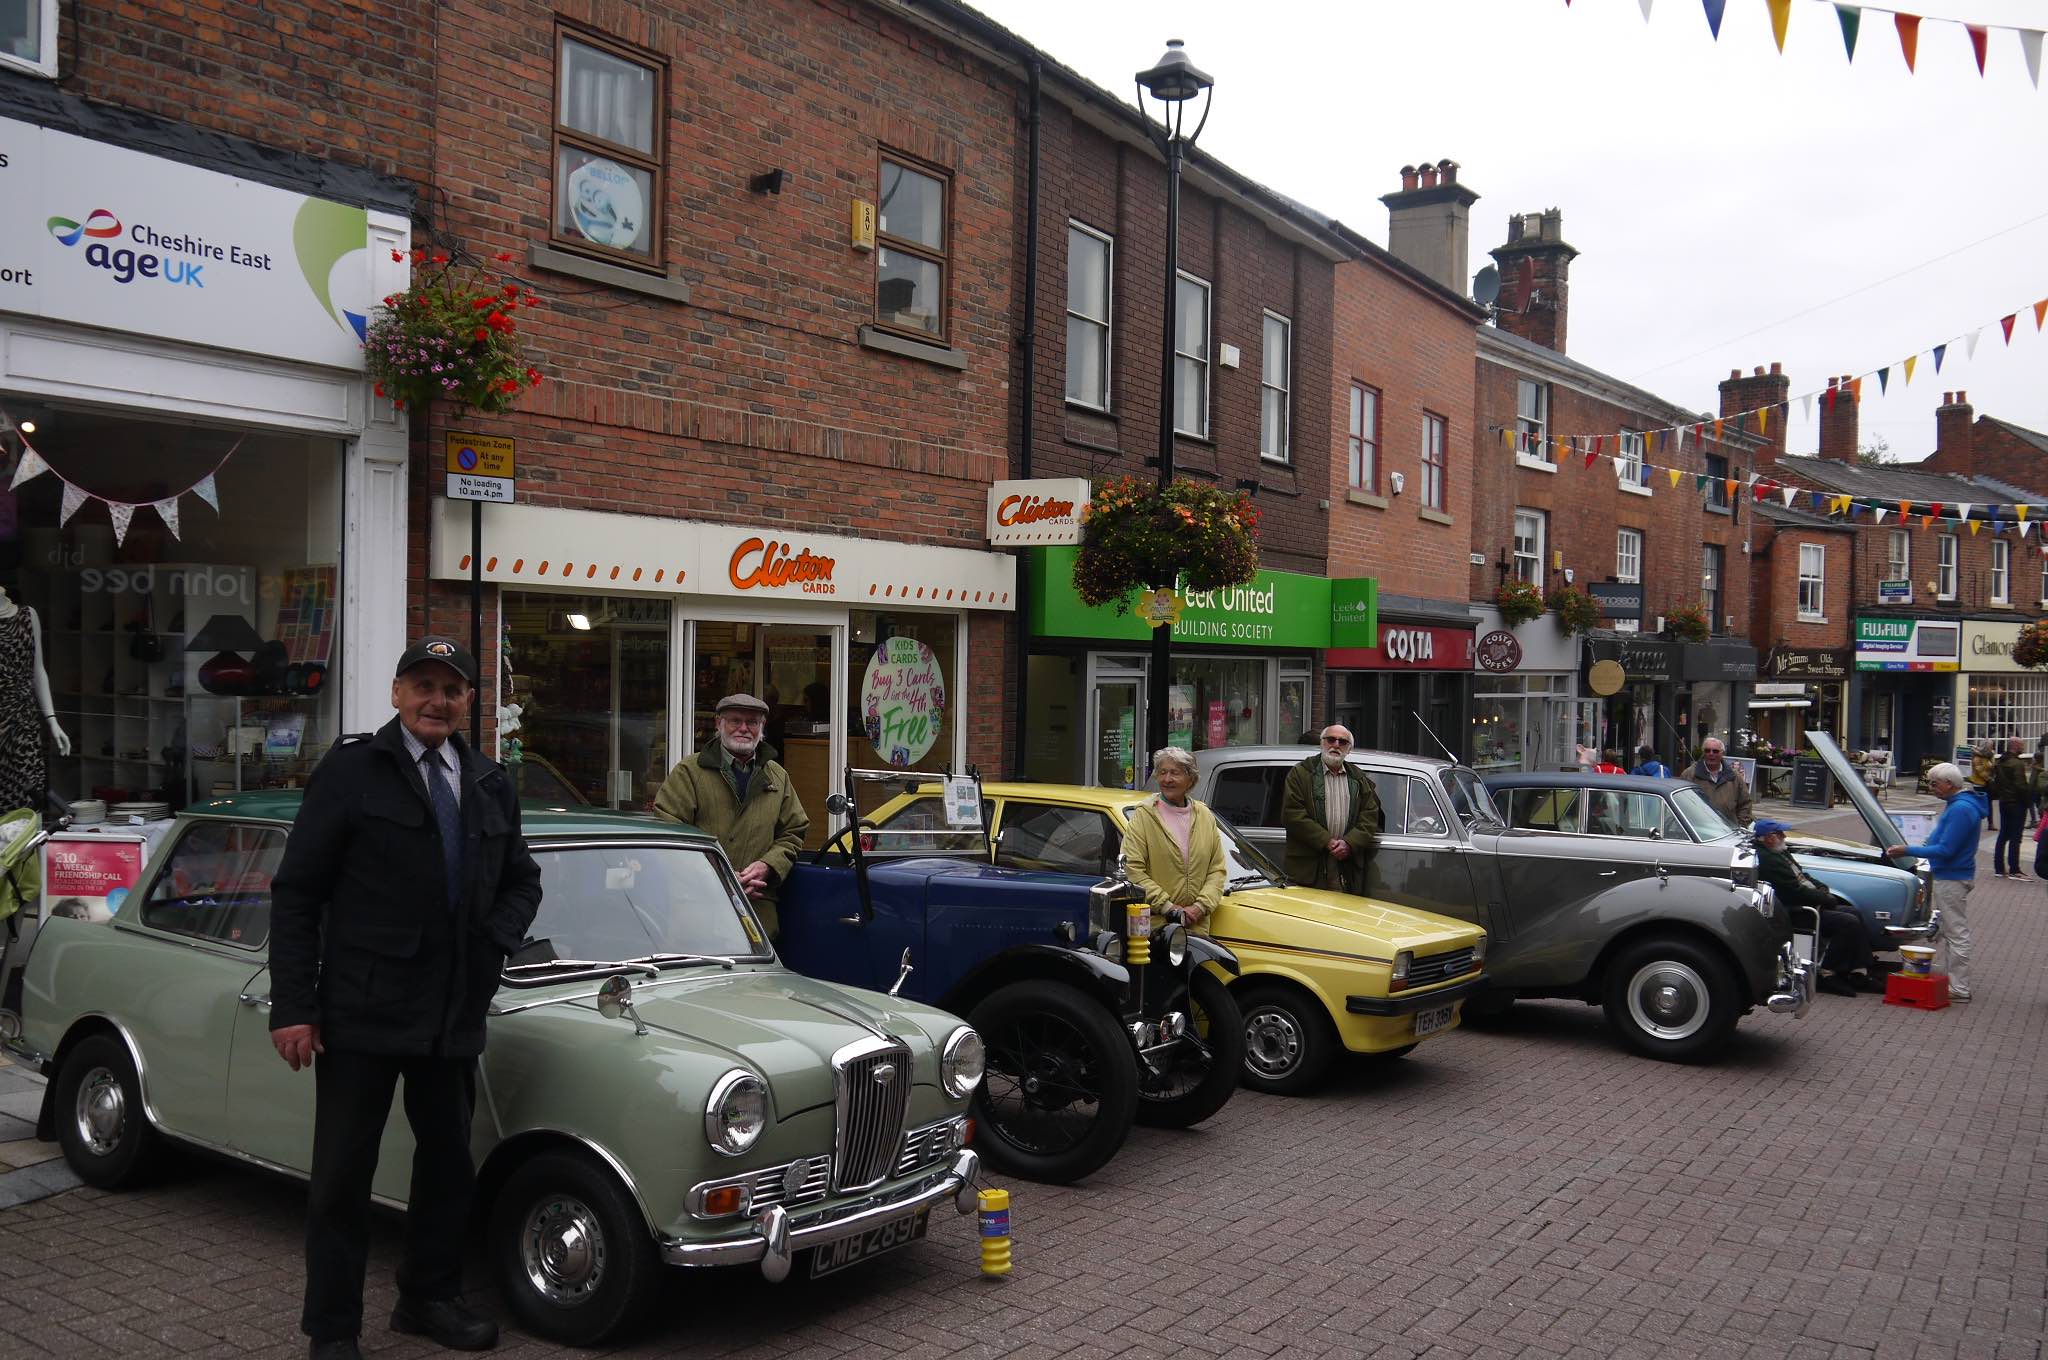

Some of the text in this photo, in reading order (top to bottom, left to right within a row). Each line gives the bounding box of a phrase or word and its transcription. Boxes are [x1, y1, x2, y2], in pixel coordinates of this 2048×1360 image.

[131, 224, 271, 271] Cheshire East
[85, 243, 204, 288] age UK
[0, 265, 33, 286] ort
[450, 436, 512, 450] Pedestrian Zone
[480, 451, 505, 463] At any
[483, 462, 501, 471] time
[458, 487, 468, 495] 10
[460, 478, 502, 490] No loading
[996, 494, 1075, 528] Clinton
[1048, 518, 1074, 526] CARDS
[729, 537, 836, 590] Clinton
[802, 582, 836, 595] CARDS
[1221, 582, 1275, 615] United
[1333, 601, 1357, 612] Leek
[1333, 612, 1367, 624] United
[1174, 620, 1274, 641] BUILDING SOCIETY
[1862, 622, 1908, 637] FUJIFILM
[894, 640, 914, 651] KIDS
[1386, 629, 1434, 664] COSTA
[1485, 634, 1514, 647] COSTA
[890, 653, 919, 665] CARDS
[1481, 654, 1514, 670] COFFEE
[1776, 653, 1788, 675] Mr
[1788, 652, 1809, 666] Simms
[1820, 653, 1834, 664] Olde
[1807, 664, 1845, 676] Sweet Shoppe
[872, 664, 935, 701] Buy 3 Cards
[909, 687, 927, 713] 4th
[882, 706, 928, 749] Free
[63, 863, 94, 872] WEEKLY
[55, 871, 122, 881] FRIENDSHIP CALL
[816, 1233, 864, 1272] CMB
